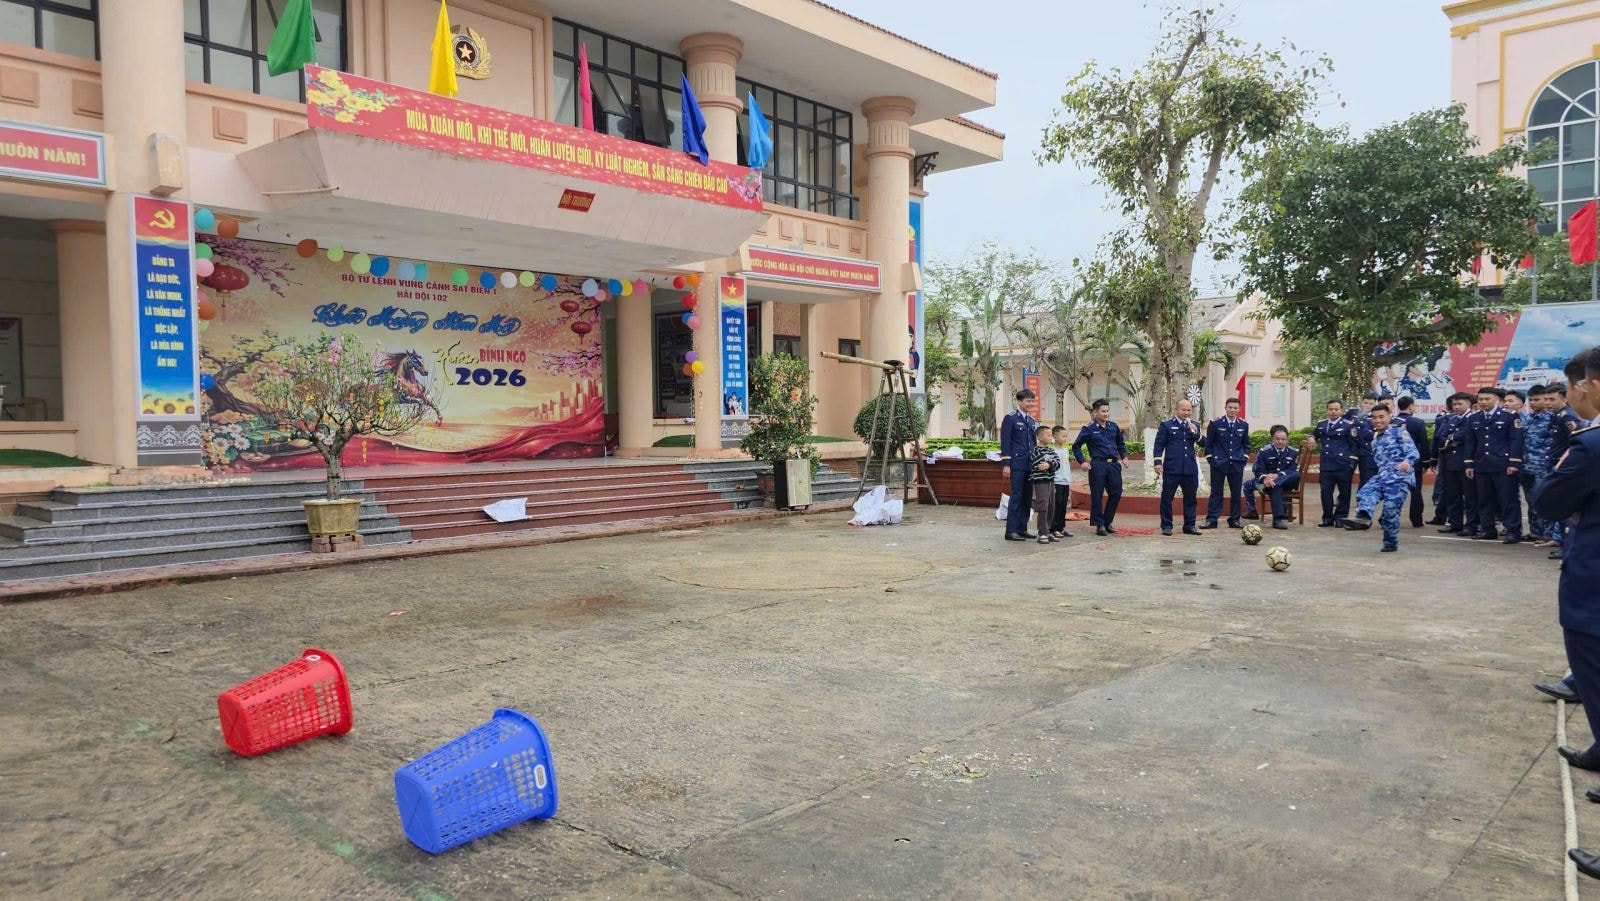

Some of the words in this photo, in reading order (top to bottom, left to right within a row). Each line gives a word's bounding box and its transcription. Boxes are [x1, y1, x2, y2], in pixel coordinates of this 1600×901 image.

[43, 146, 86, 166] NĂM!
[406, 108, 428, 131] MÙA
[430, 114, 454, 138] XUÂN
[478, 124, 492, 146] KHÍ
[494, 123, 508, 148] THẾ
[530, 132, 550, 157] HUẤN
[552, 140, 575, 165] LUYỆN
[595, 147, 604, 168] KỶ
[605, 152, 621, 175] LUẬT
[666, 163, 683, 185] SÀNG
[685, 168, 702, 189] CHIẾN
[716, 177, 727, 194] CAO
[148, 272, 155, 283] LÀ
[372, 277, 396, 286] LỆNH
[146, 289, 154, 299] LÀ
[415, 292, 430, 300] ĐỘI
[432, 293, 447, 301] 102
[145, 305, 152, 316] LÀ
[150, 340, 158, 350] LÀ
[455, 367, 526, 386] 2026
